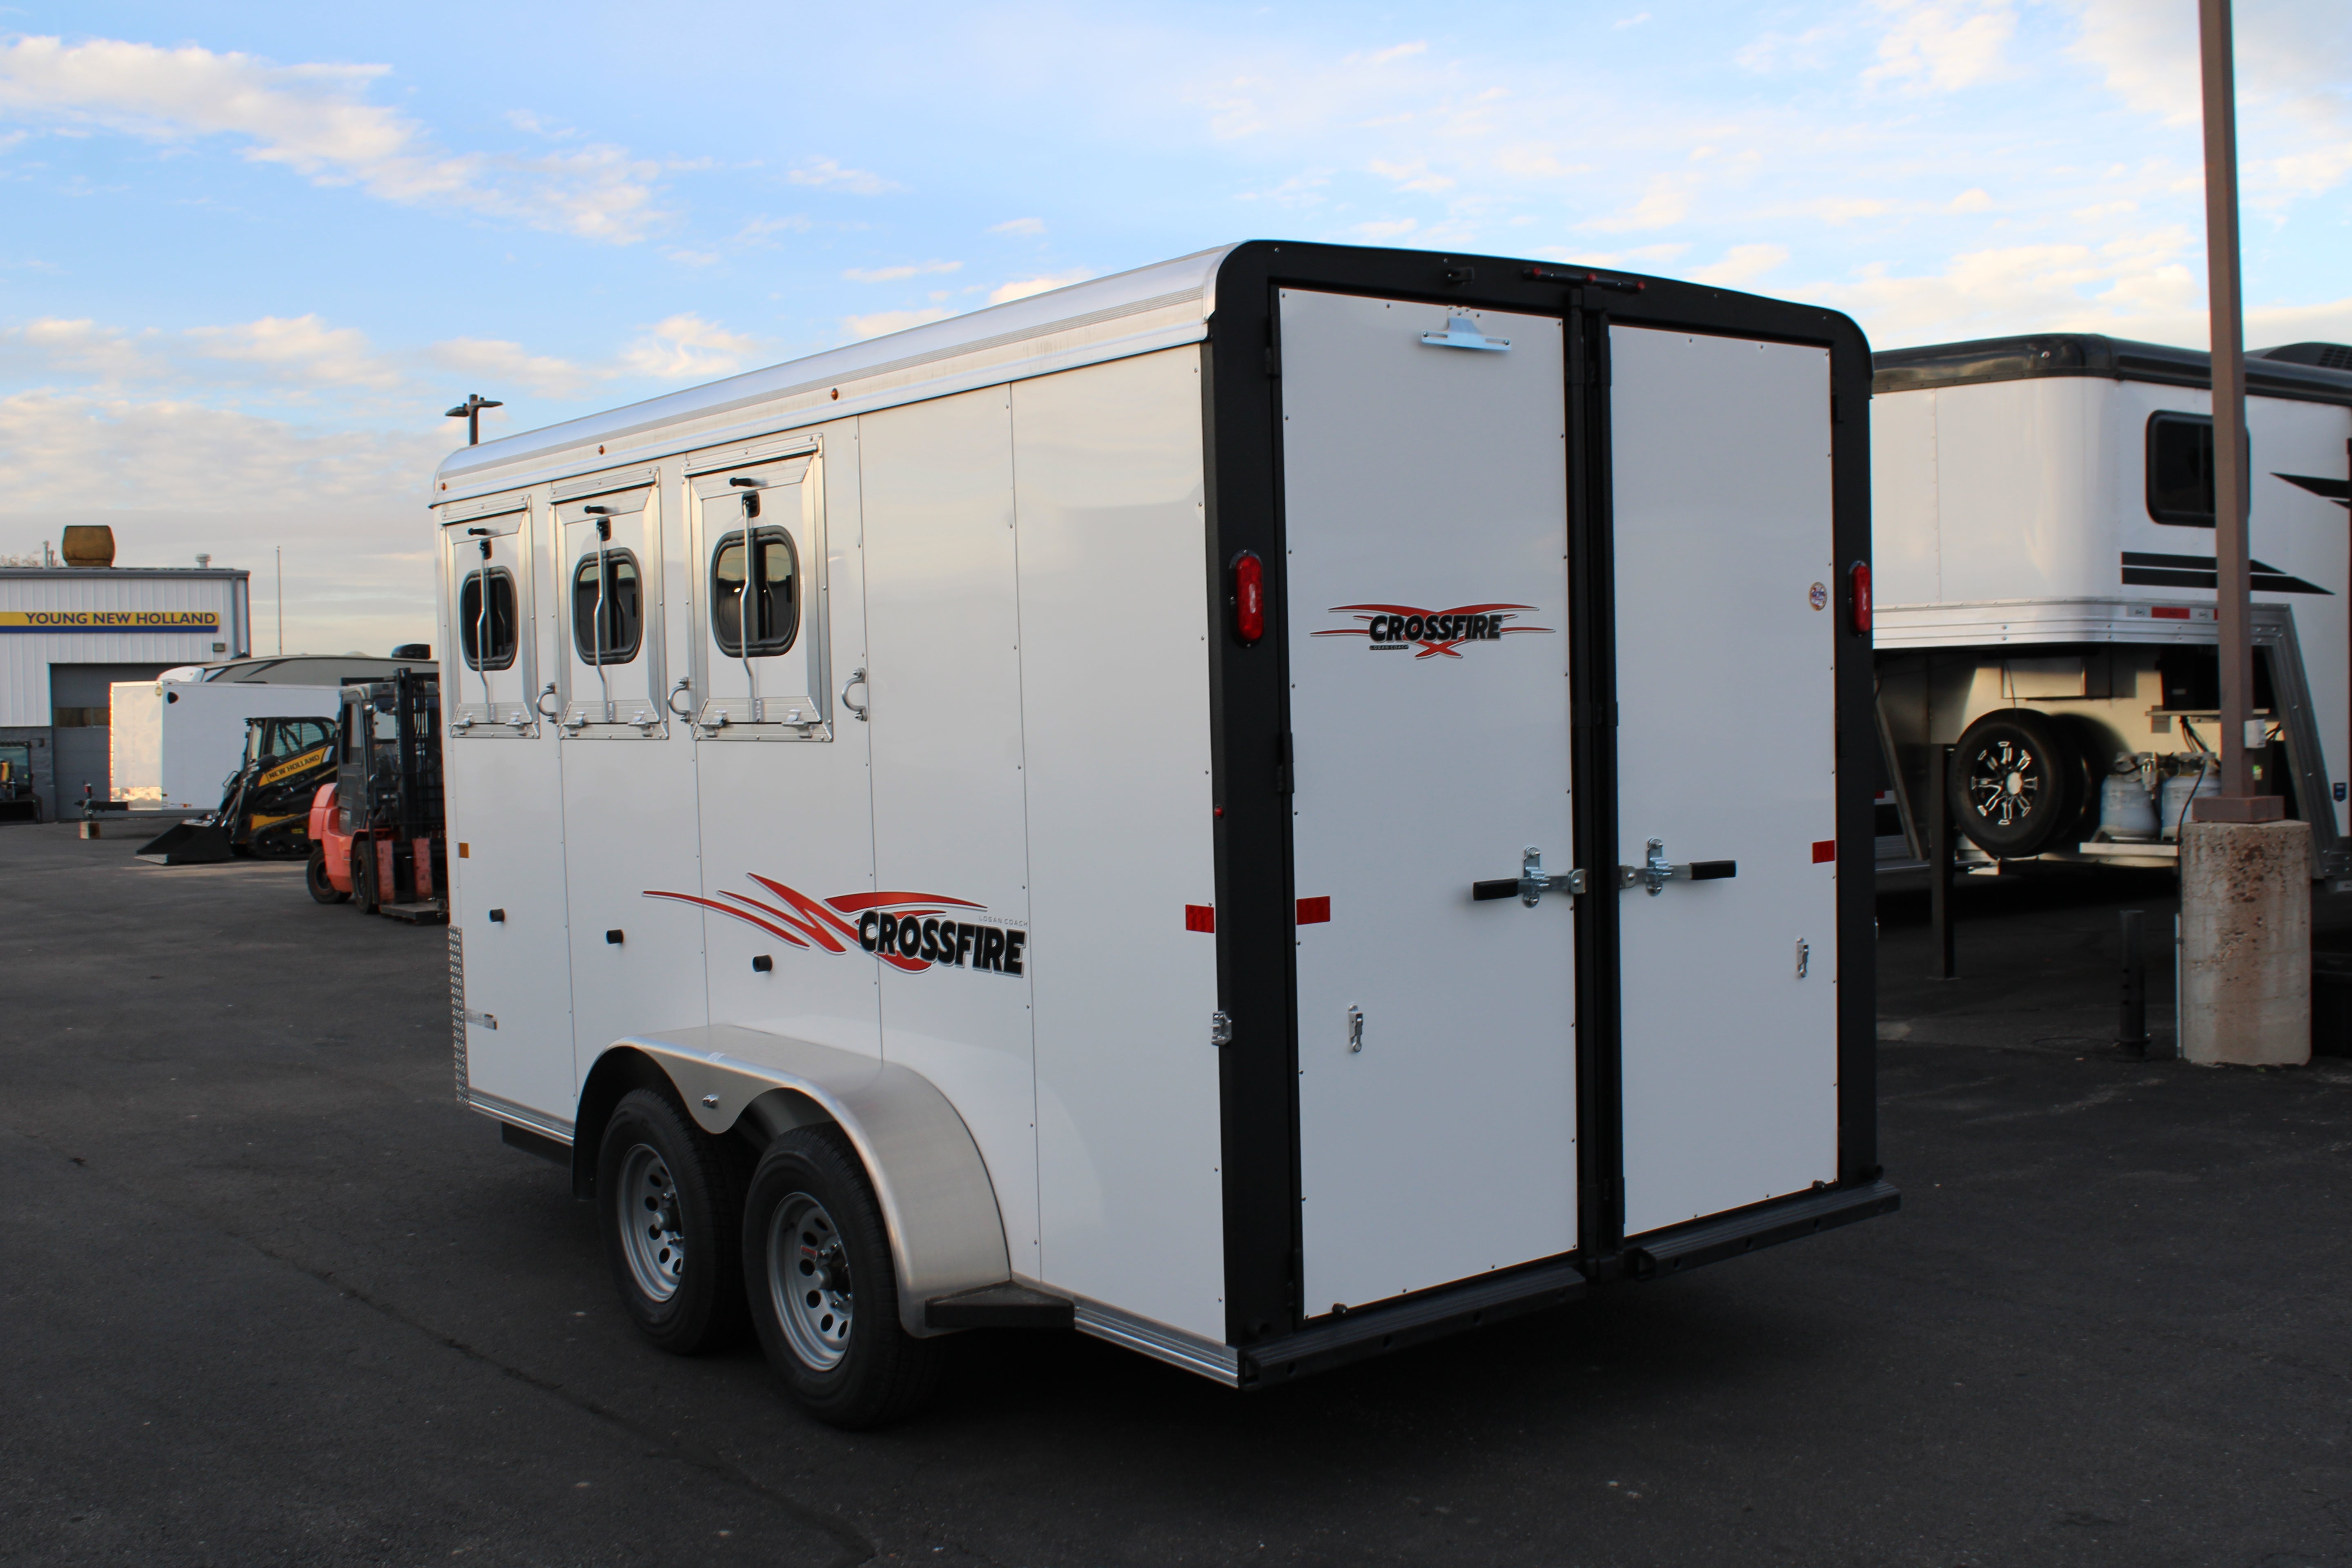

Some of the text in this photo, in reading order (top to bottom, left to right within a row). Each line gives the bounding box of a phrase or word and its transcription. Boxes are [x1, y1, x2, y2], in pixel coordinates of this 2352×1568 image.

[25, 613, 216, 624] YOUNG NEW HOLLAND
[1369, 614, 1503, 641] CROSSFIRE
[269, 754, 320, 779] NEW HOLLAND
[979, 915, 1028, 927] LOGAN COACH
[858, 910, 1026, 977] CROSSFIRE
